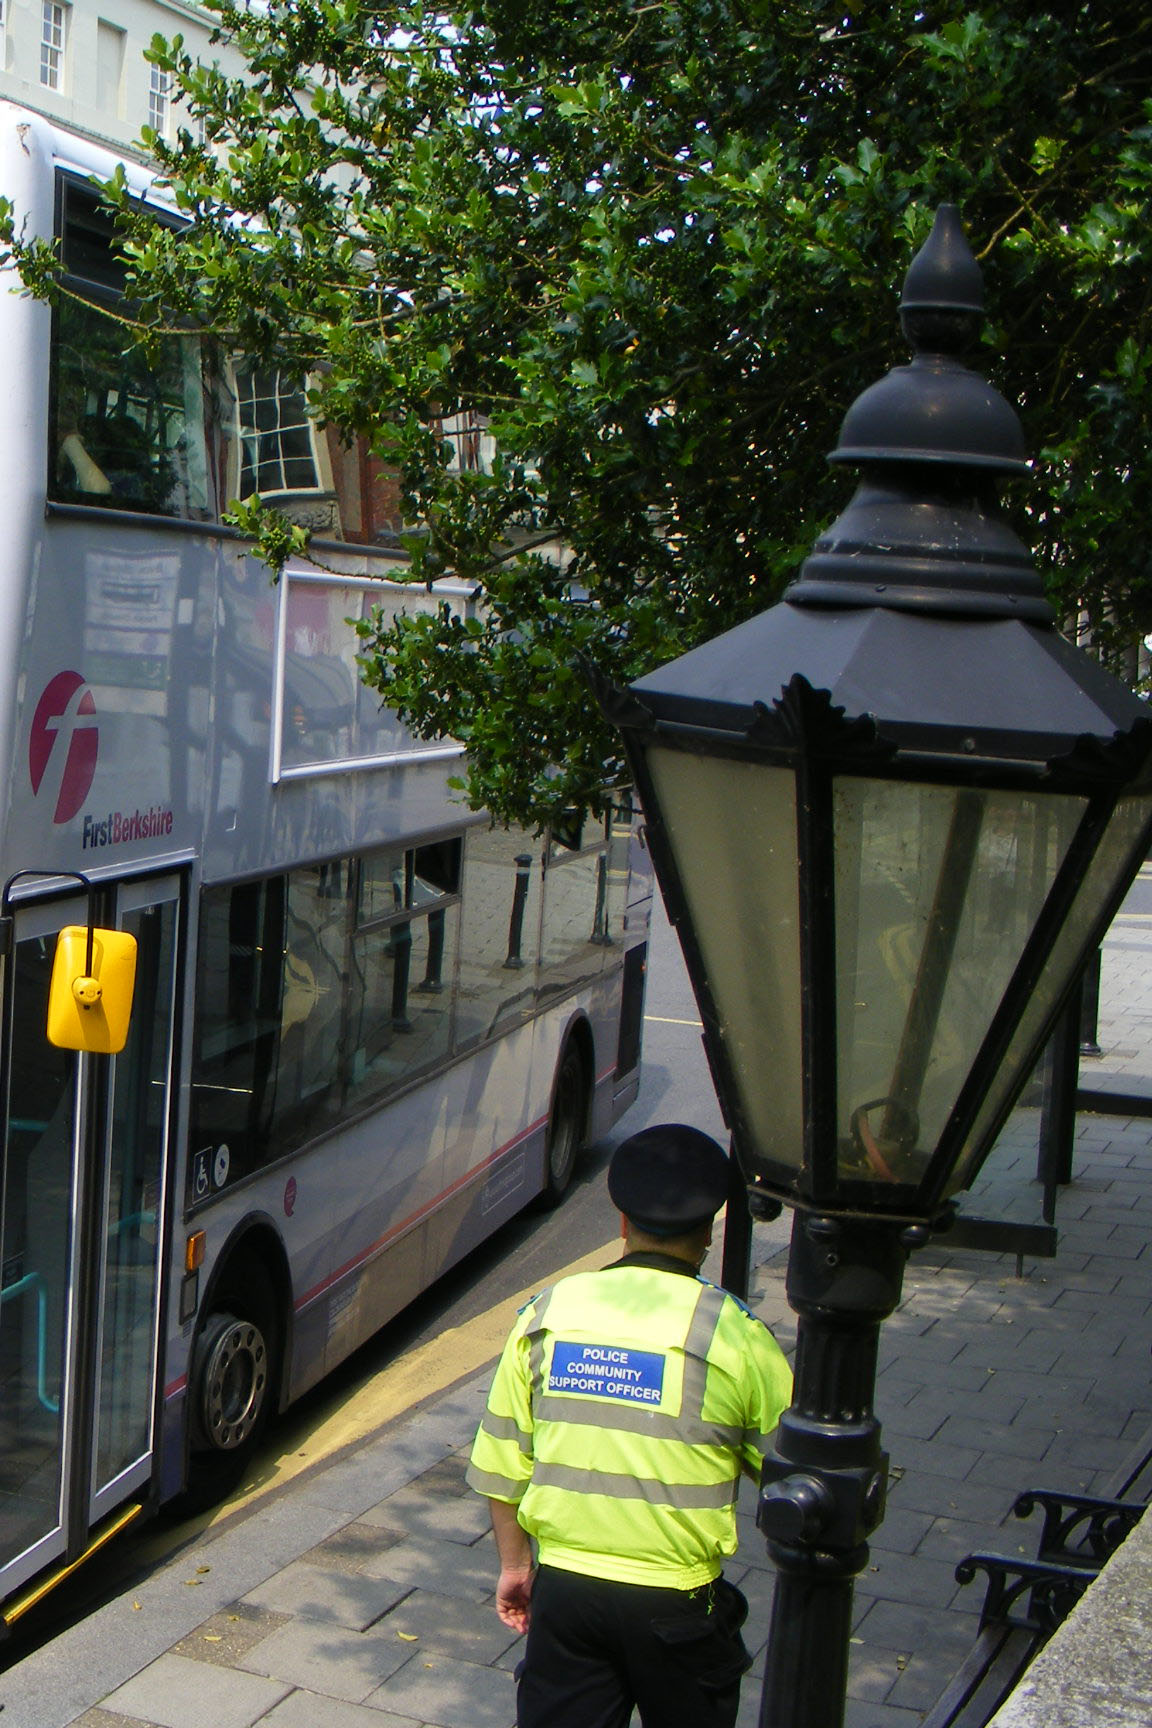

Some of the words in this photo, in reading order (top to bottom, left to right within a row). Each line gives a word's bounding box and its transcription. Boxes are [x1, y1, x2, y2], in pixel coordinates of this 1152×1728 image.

[582, 1347, 629, 1365] POLICE
[566, 1361, 643, 1383] COMMUNITY
[548, 1374, 605, 1393] SUPPORT
[605, 1381, 662, 1402] OFFICER
